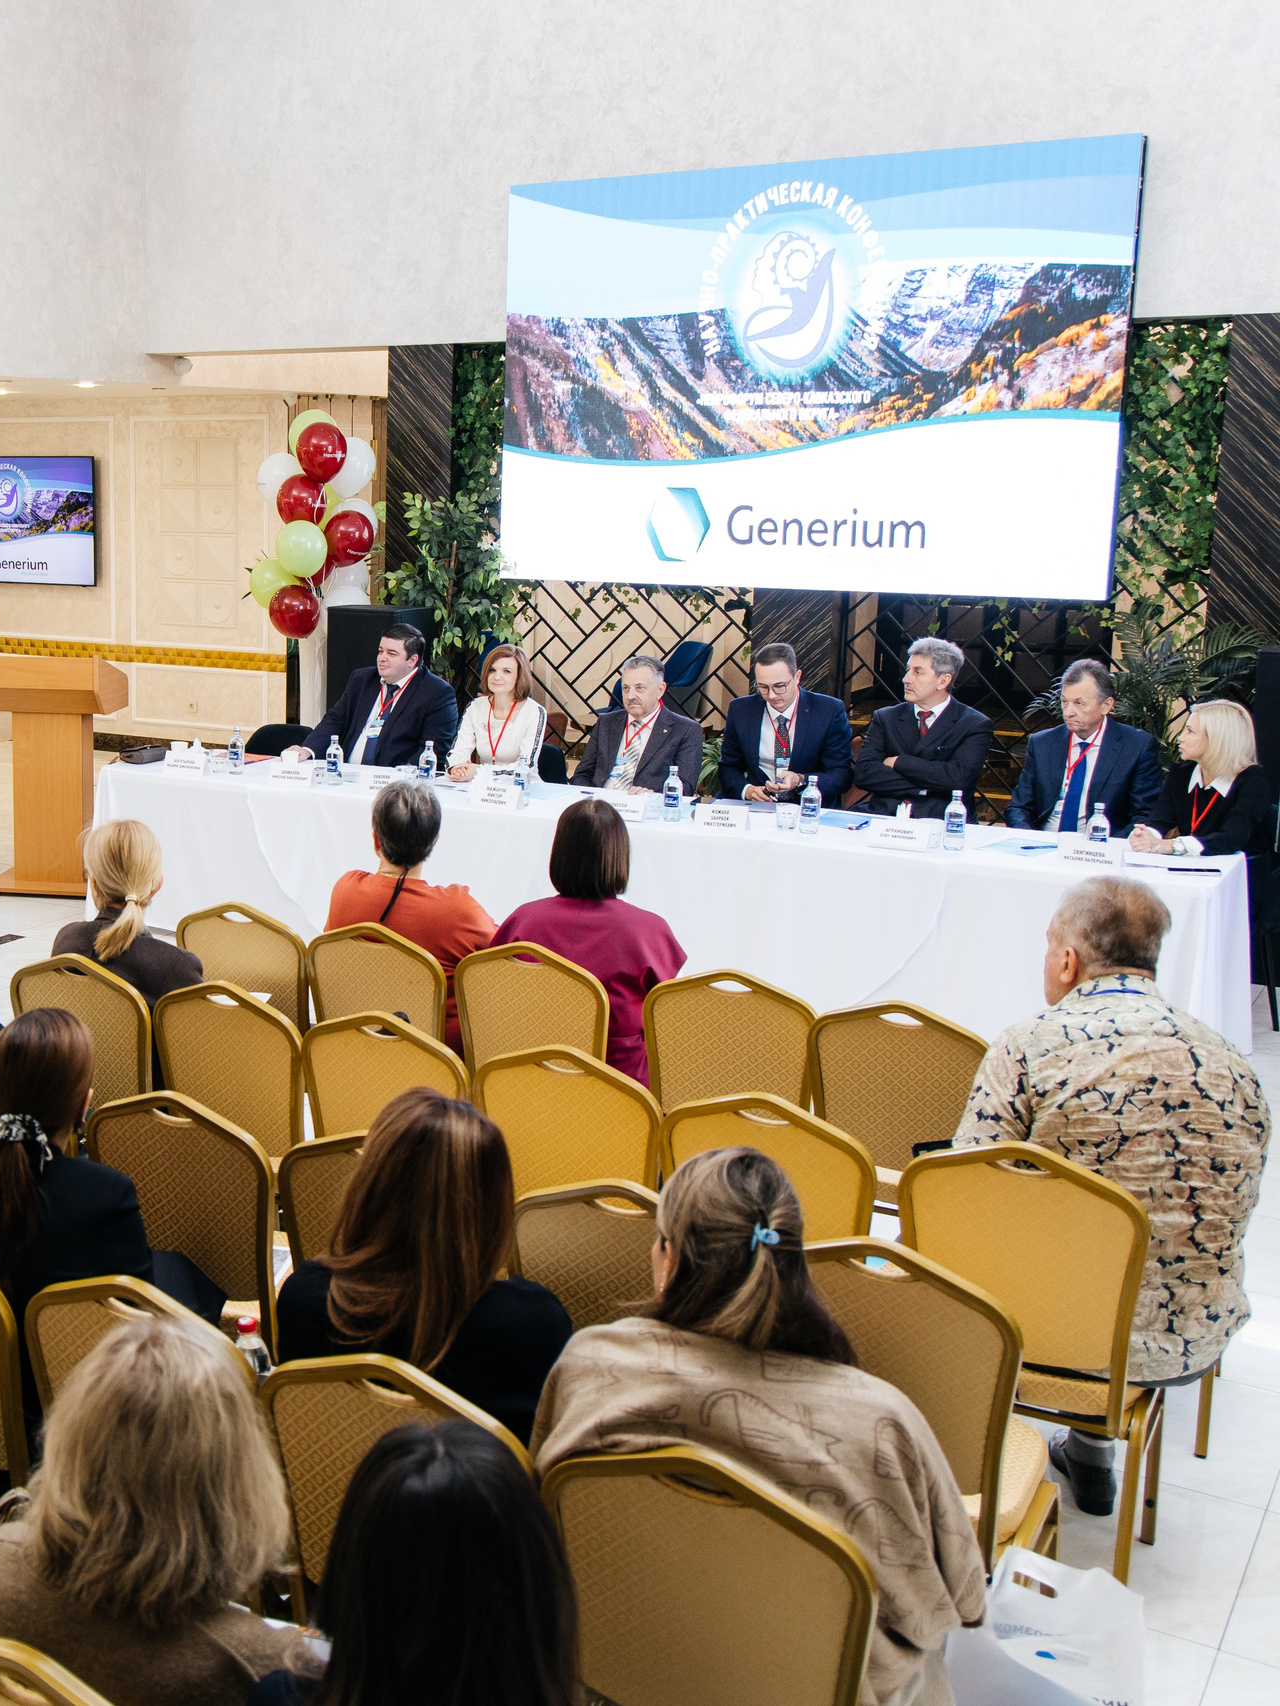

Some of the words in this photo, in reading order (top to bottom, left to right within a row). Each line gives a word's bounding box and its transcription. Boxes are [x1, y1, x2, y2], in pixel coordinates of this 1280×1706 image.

[726, 504, 926, 549] Generium
[1072, 849, 1106, 858] ЗВЯГИНЦЕВА
[1084, 857, 1113, 865] ВАЛЕРЬЕВНА
